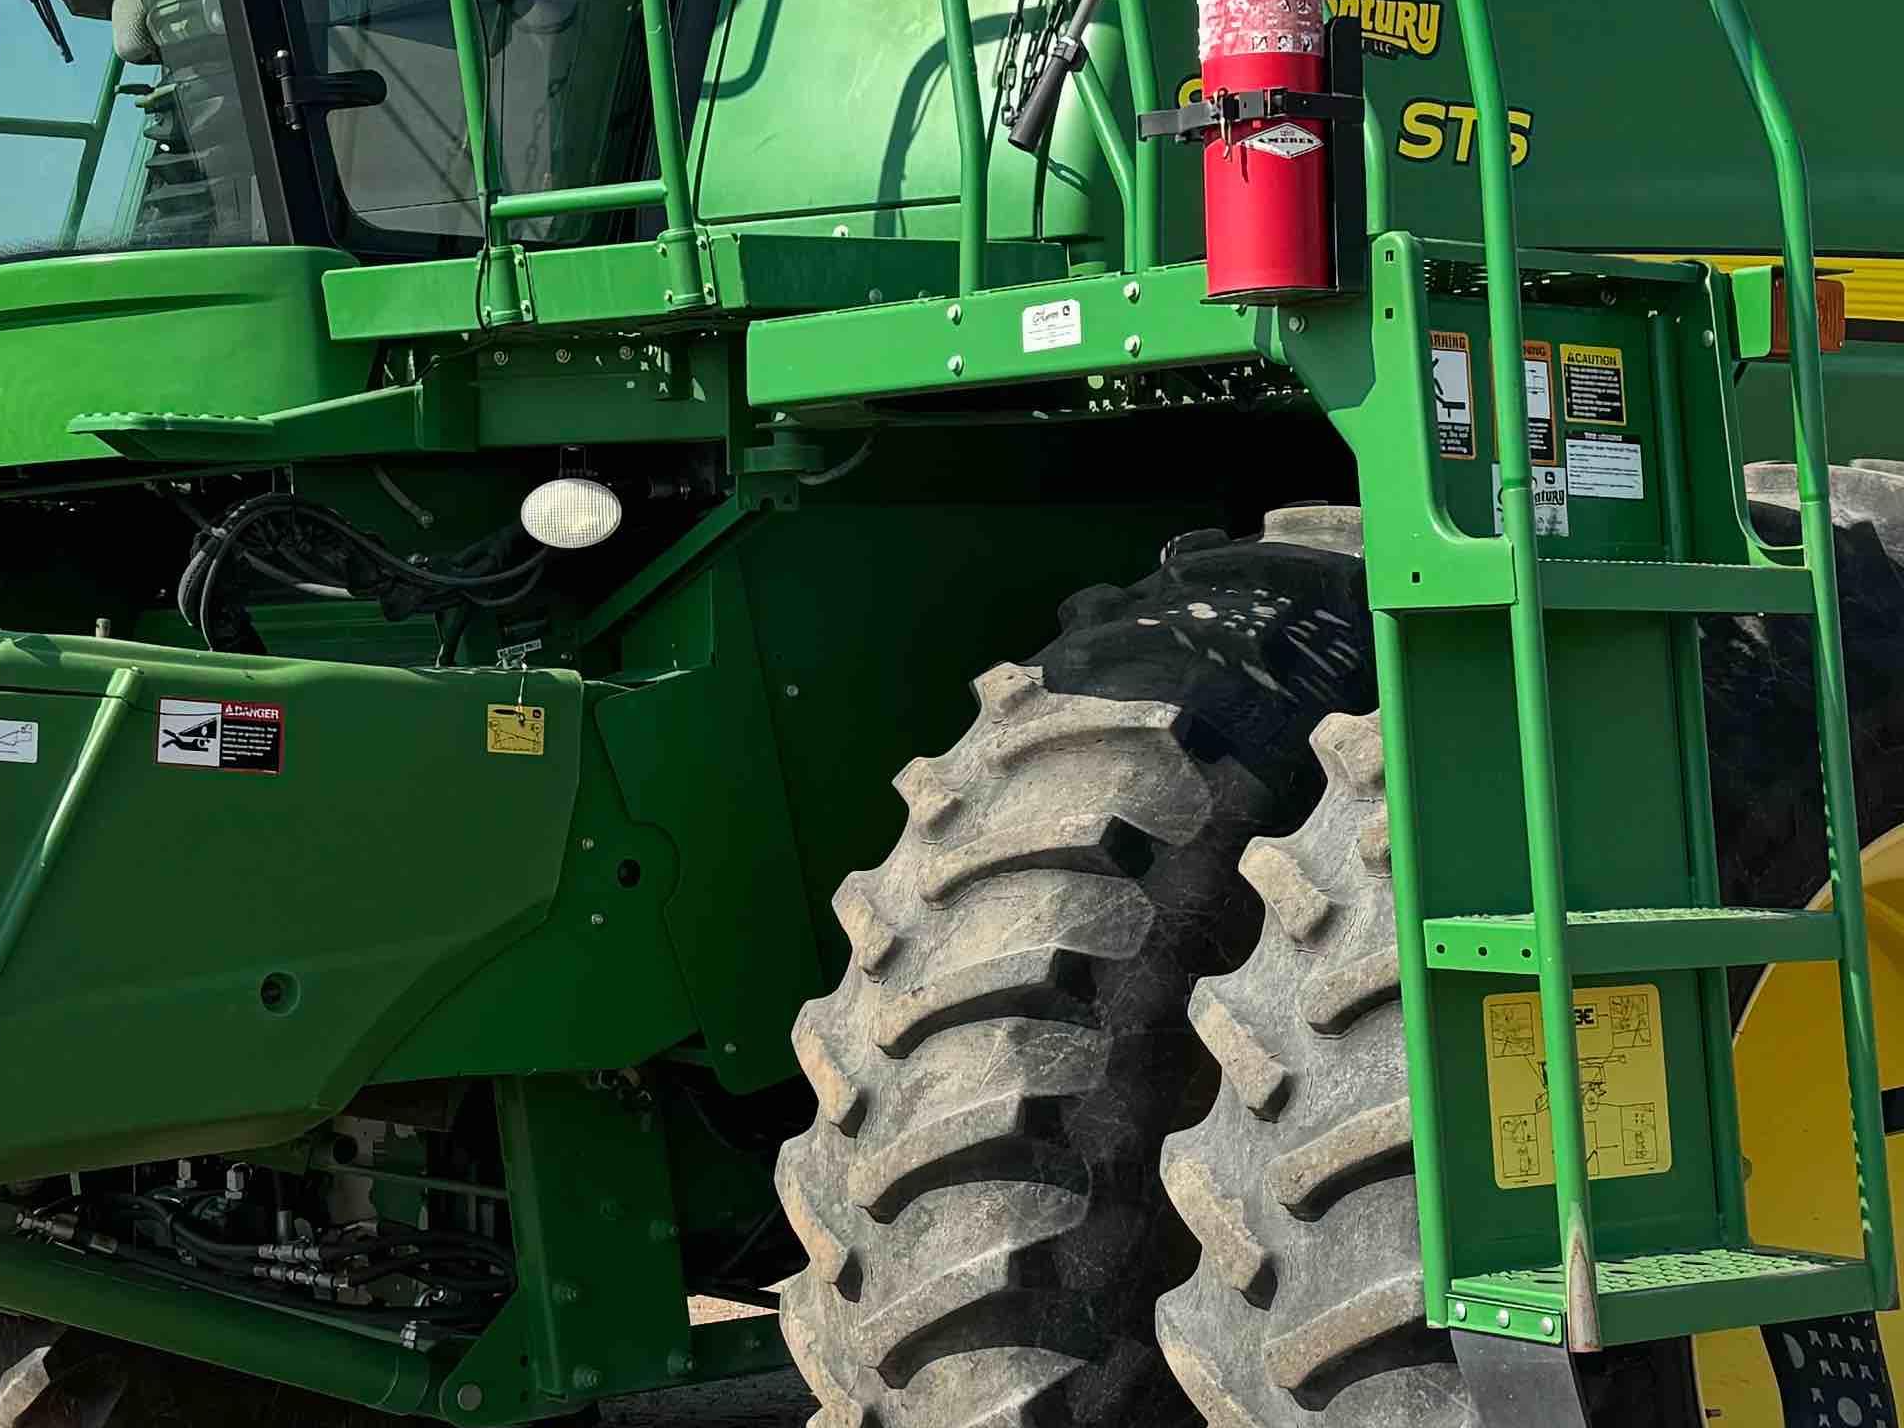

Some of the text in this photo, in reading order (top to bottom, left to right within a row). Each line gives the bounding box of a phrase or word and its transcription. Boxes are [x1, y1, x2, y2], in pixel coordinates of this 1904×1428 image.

[1431, 335, 1466, 349] RNING
[1523, 346, 1547, 357] NING
[1575, 353, 1618, 367] CAUTION
[235, 705, 279, 719] DANGER
